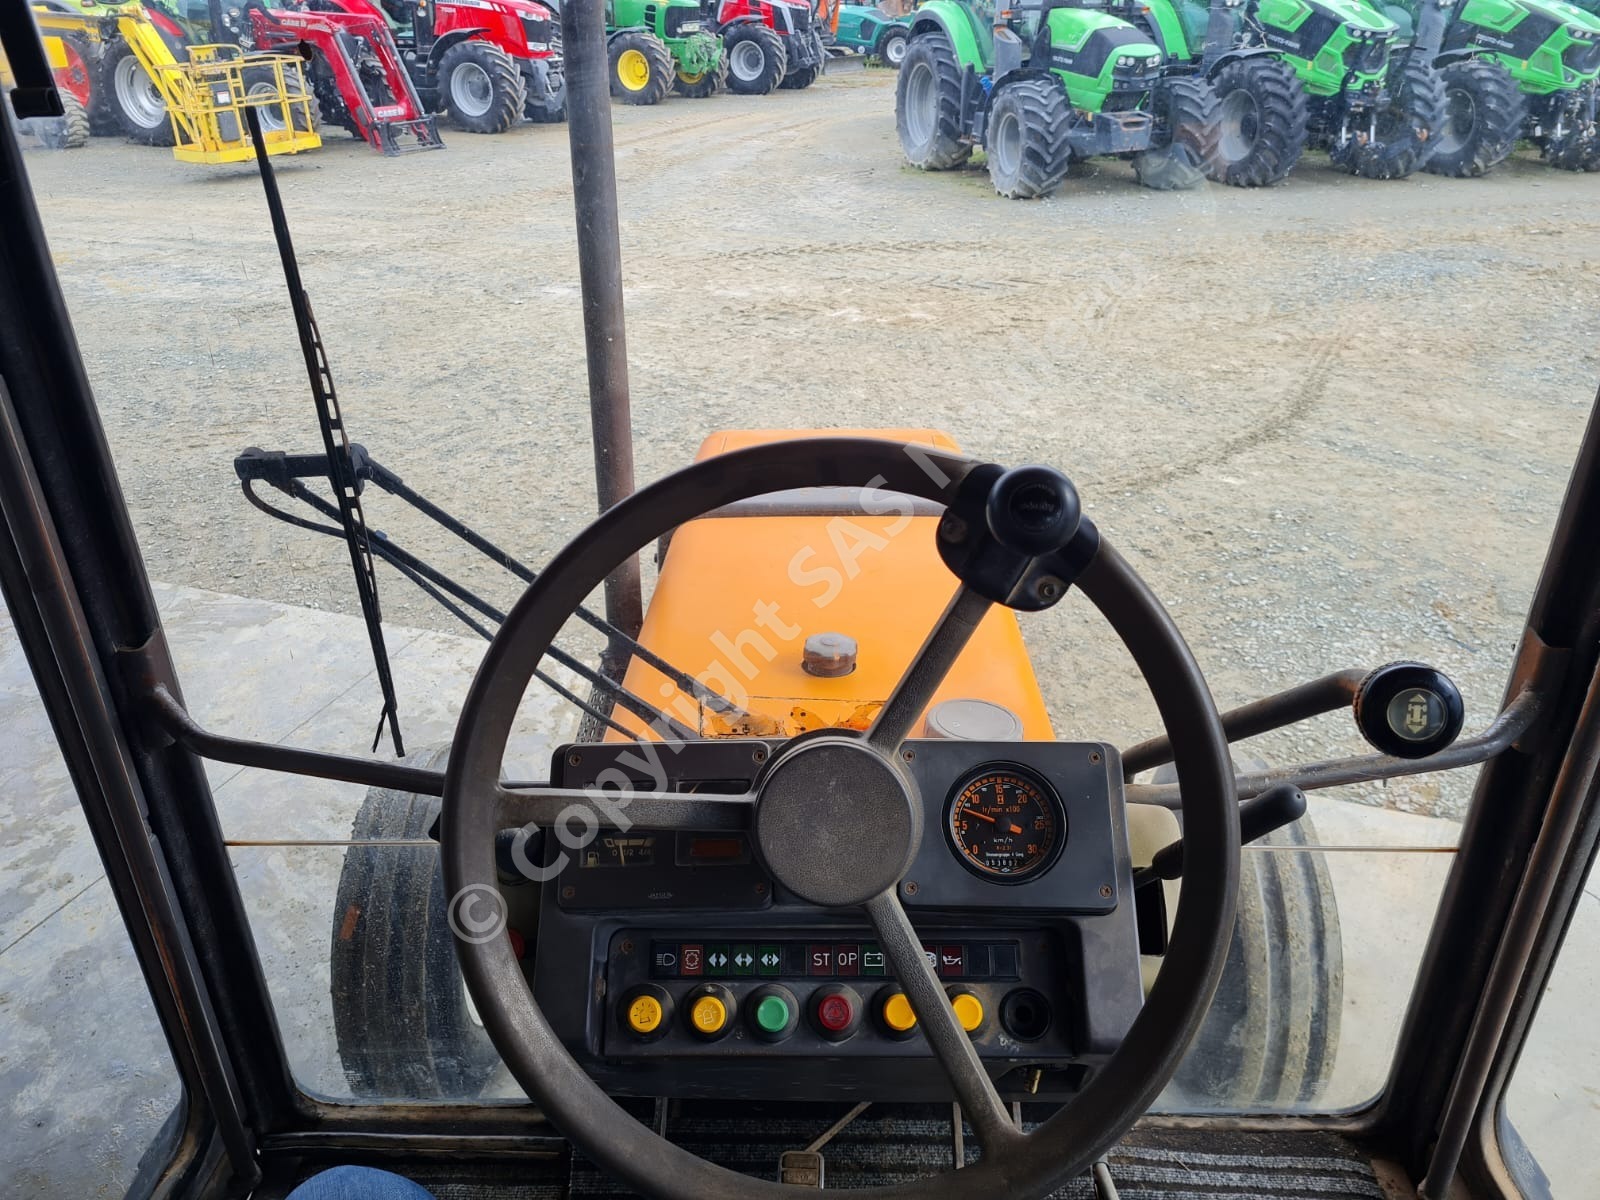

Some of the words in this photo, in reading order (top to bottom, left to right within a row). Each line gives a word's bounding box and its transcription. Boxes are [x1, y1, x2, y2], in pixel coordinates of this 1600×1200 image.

[971, 793, 980, 804] 10
[1017, 793, 1028, 804] 20
[961, 820, 968, 830] 5
[1034, 819, 1047, 830] 25
[993, 836, 1013, 844] km/h
[972, 844, 979, 855] 0
[1027, 844, 1038, 854] 30
[813, 952, 830, 966] ST
[838, 952, 857, 966] OP
